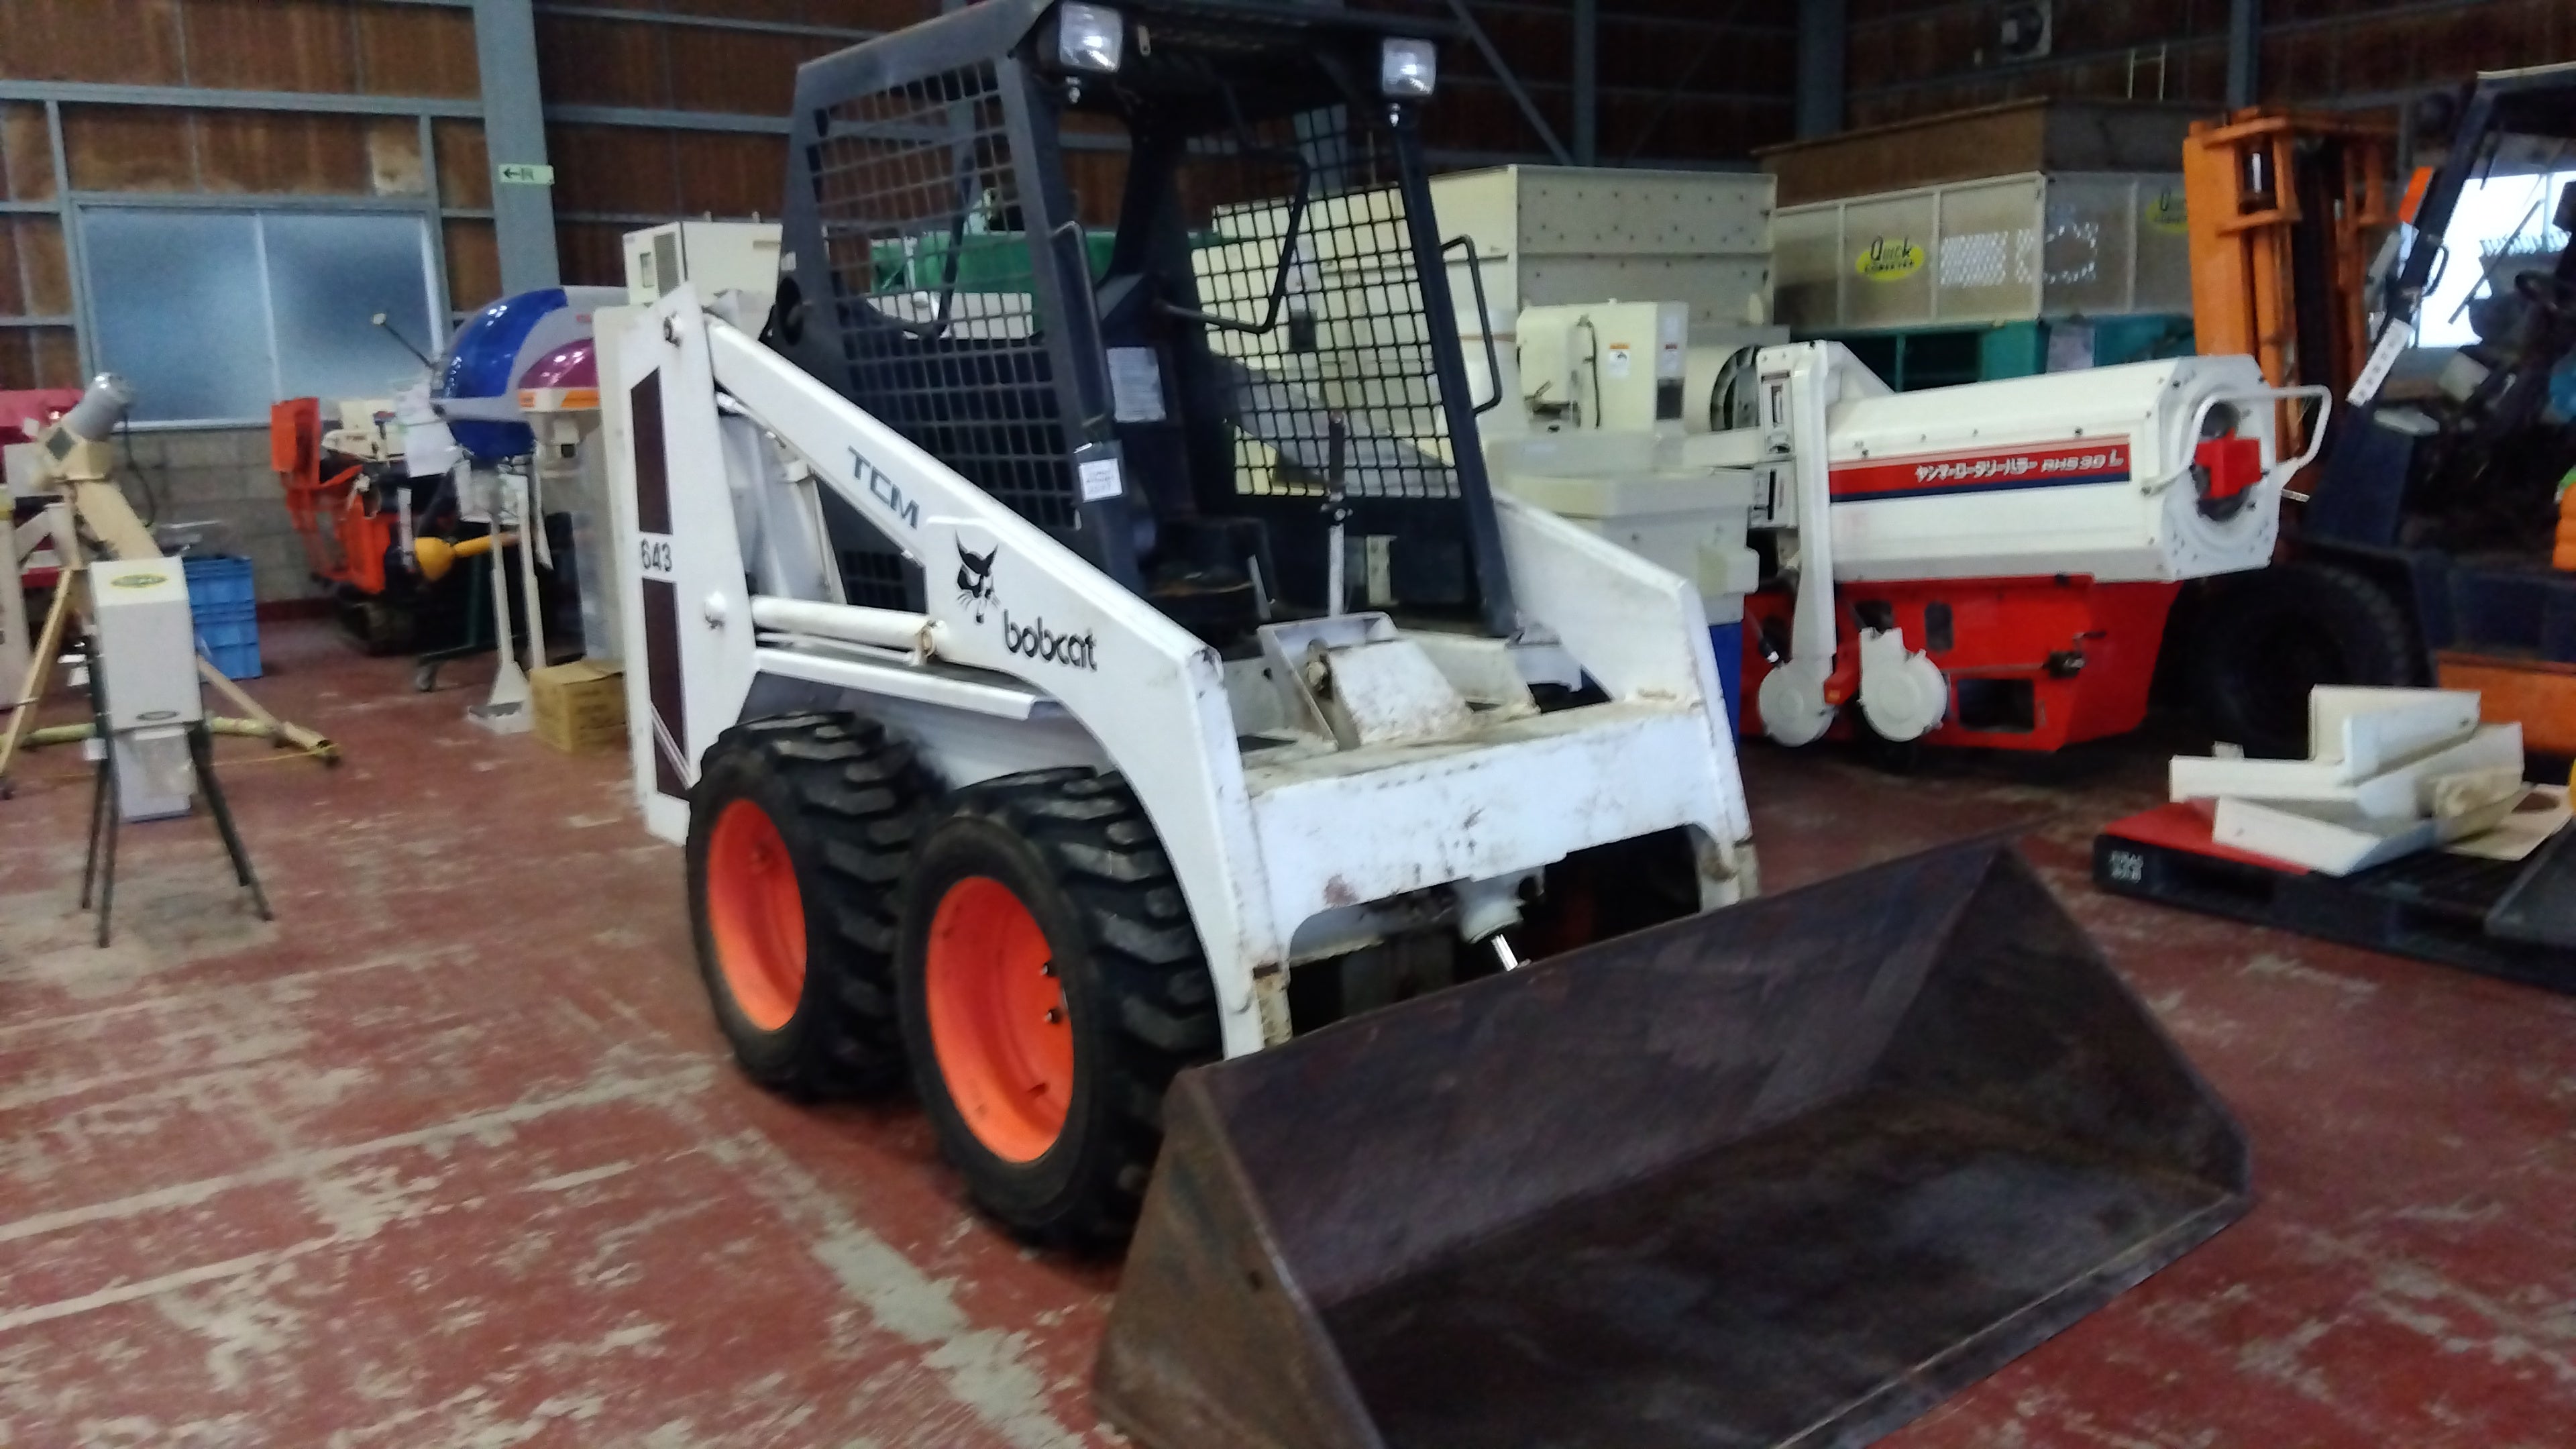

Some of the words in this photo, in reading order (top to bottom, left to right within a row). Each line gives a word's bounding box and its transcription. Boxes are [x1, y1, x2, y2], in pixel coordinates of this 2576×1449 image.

[847, 445, 919, 530] TCM
[641, 539, 673, 572] 643
[1004, 608, 1098, 672] bobcat
